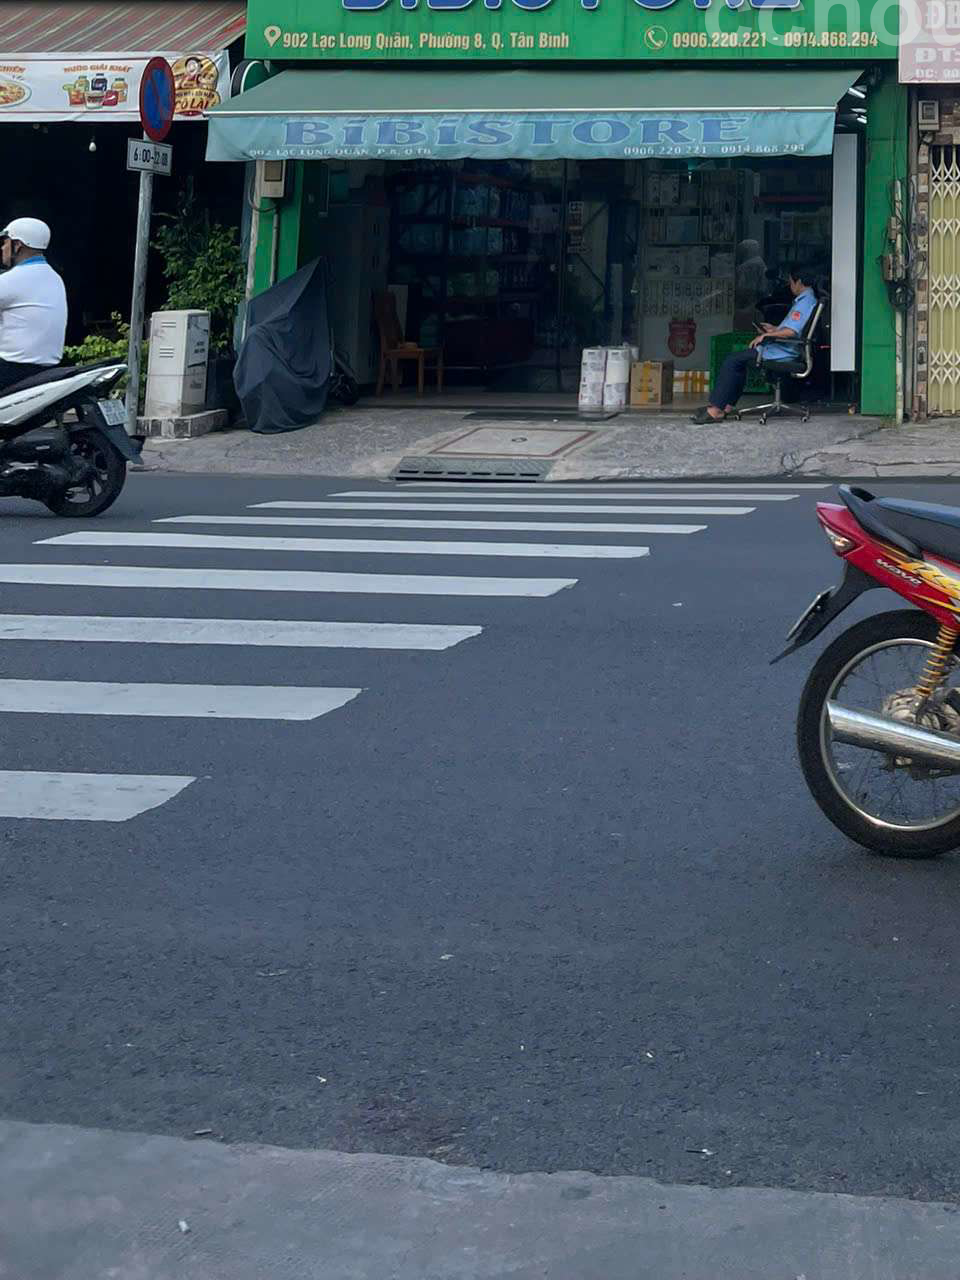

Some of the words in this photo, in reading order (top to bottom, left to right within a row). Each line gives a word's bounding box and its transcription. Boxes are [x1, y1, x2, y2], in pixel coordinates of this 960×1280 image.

[282, 32, 308, 49] 902
[312, 32, 336, 52] Lạc
[340, 32, 371, 52] Long
[419, 31, 470, 52] Phường
[491, 32, 504, 51] Q.
[510, 31, 534, 49] Tân
[672, 31, 767, 48] 0906.220.221
[784, 31, 878, 48] 0914.868.294
